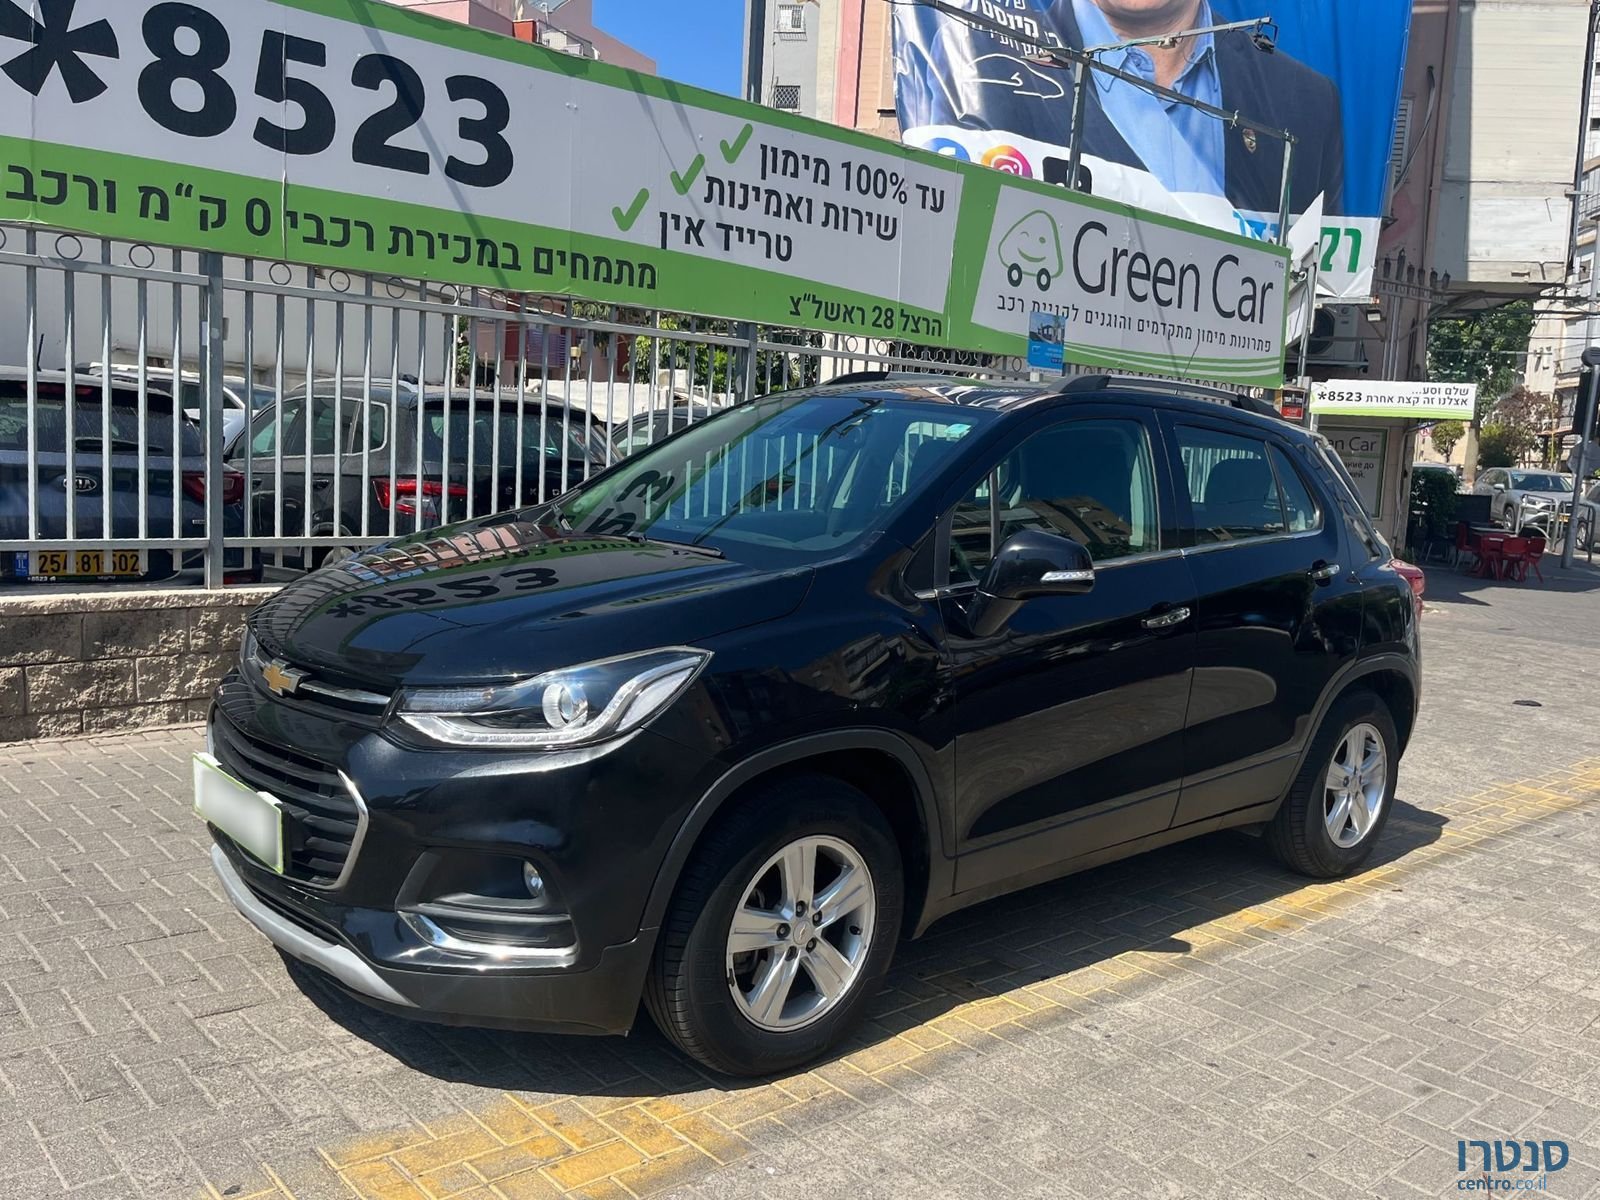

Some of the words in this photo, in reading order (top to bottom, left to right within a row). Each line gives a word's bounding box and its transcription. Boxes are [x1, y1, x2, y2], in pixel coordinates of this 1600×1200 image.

[760, 143, 830, 187] מימון
[5, 164, 117, 214] ורכב
[841, 161, 908, 205] 100%
[915, 183, 945, 213] עד
[703, 175, 813, 225] ואמינות
[245, 197, 271, 237] 0
[285, 210, 375, 252] רכבי
[659, 211, 706, 251] אין
[821, 201, 898, 241] שירות
[387, 225, 522, 272] במכירת
[715, 222, 793, 262] טרייד
[533, 246, 657, 290] מתמחים
[1072, 220, 1200, 312] Green
[1212, 254, 1274, 324] Car
[789, 292, 866, 326] ראשל"צ
[871, 305, 895, 330] 28
[997, 294, 1025, 313] רכב
[899, 308, 942, 337] הרצל
[1085, 309, 1132, 331] והוגנים
[1137, 318, 1192, 341] מתקדמים
[1197, 328, 1226, 346] מימון
[1229, 334, 1271, 353] פתרונות
[1365, 395, 1394, 404] אחרת
[1396, 396, 1419, 406] קצת
[1422, 396, 1435, 405] זה
[1438, 396, 1468, 406] אצלנו
[1445, 385, 1469, 395] שלם
[1348, 436, 1377, 451] Car
